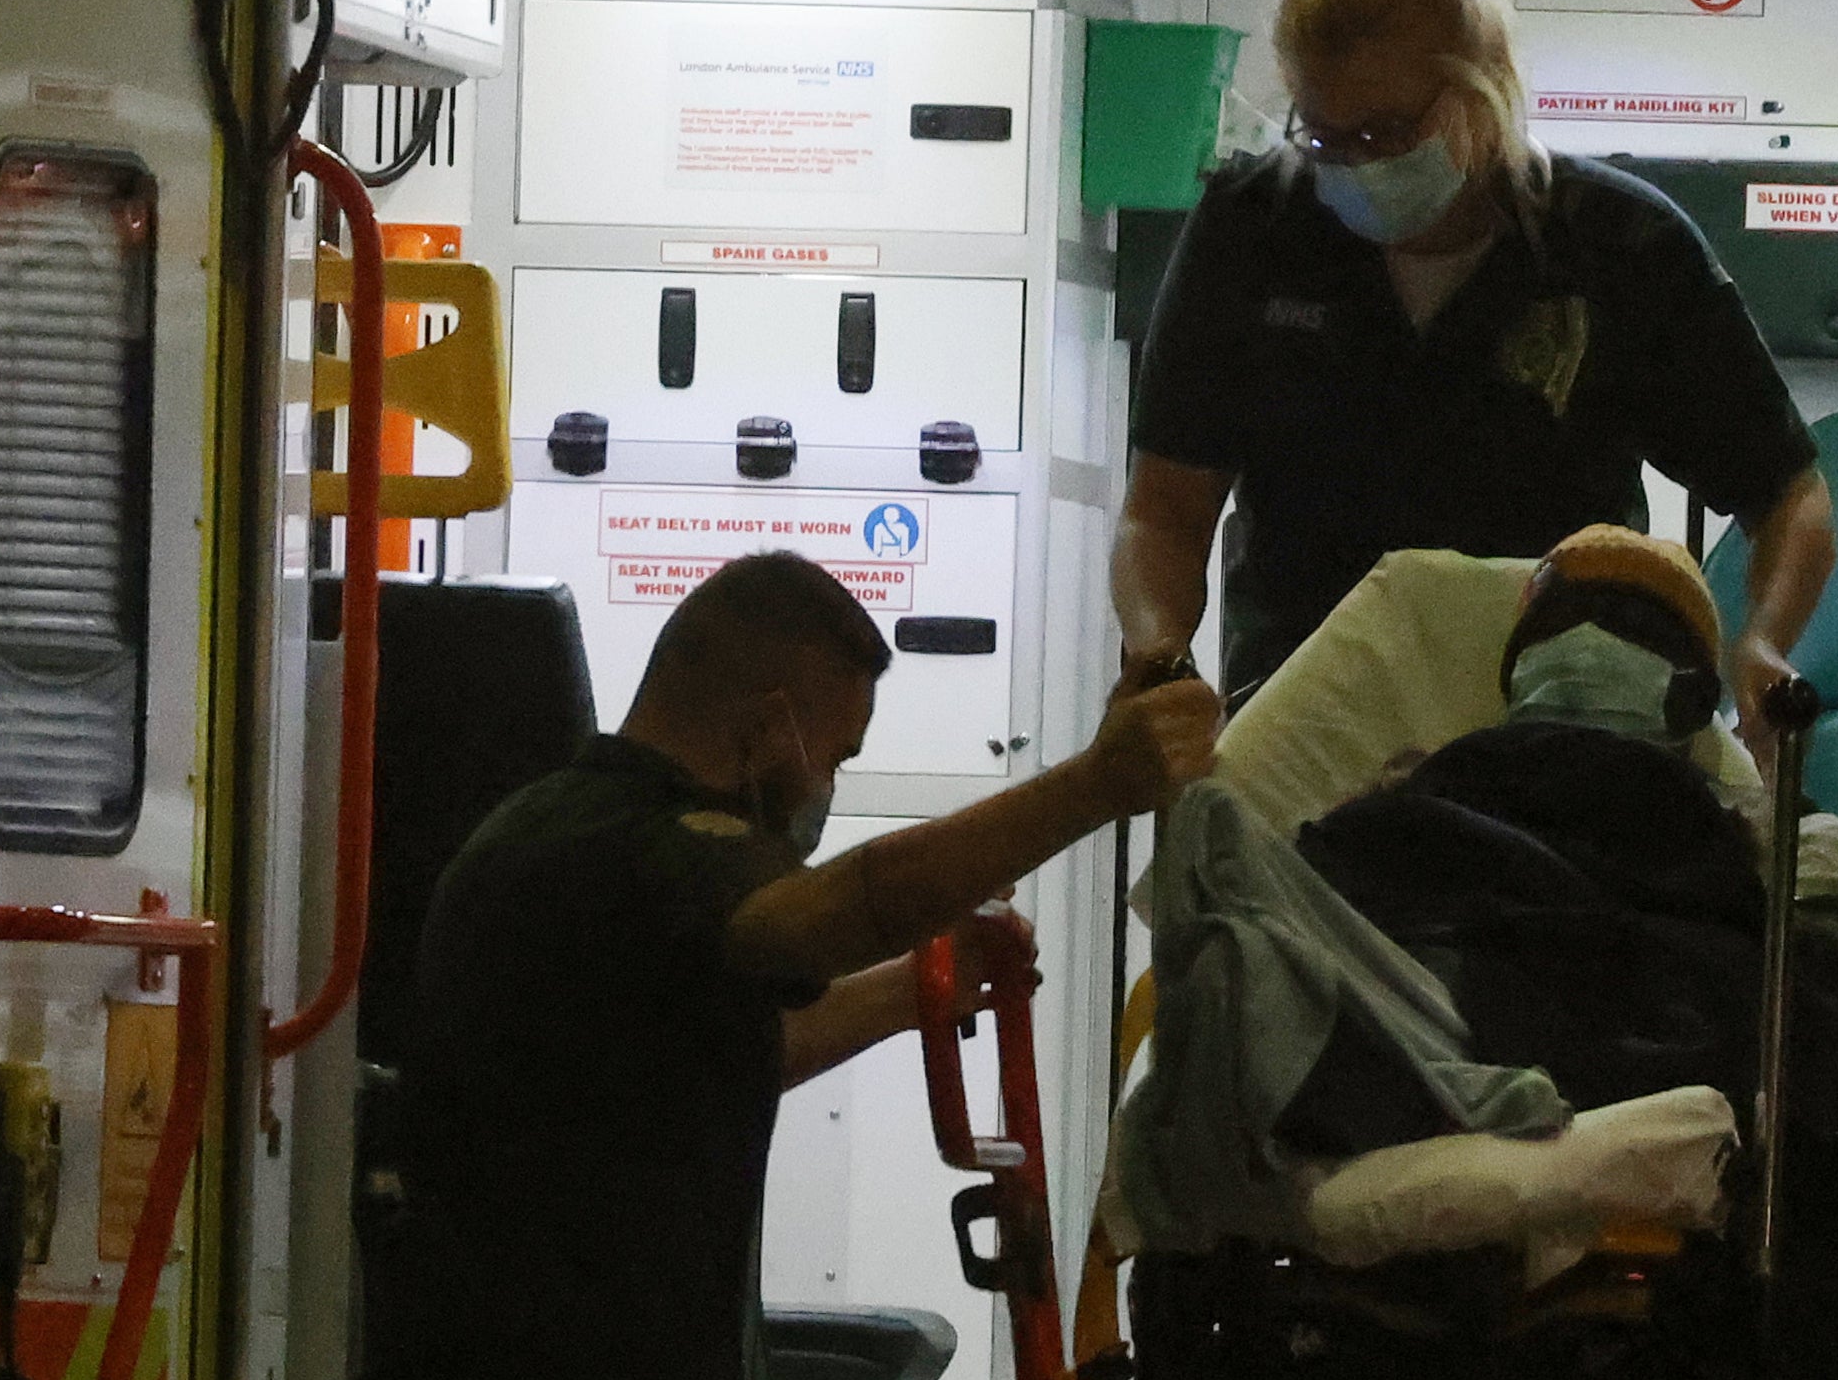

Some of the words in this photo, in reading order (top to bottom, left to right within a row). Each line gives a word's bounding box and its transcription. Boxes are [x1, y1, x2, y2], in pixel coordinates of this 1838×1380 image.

[679, 62, 722, 73] London
[725, 62, 789, 74] Ambulance
[792, 63, 831, 75] Service
[838, 62, 873, 76] NHS
[1537, 98, 1608, 111] PATIENT
[1614, 99, 1703, 113] HANDLING
[1708, 101, 1736, 114] KIT
[1757, 191, 1826, 206] SLIDING
[1770, 209, 1822, 223] WHEN
[712, 246, 766, 261] SPARE
[772, 247, 829, 262] GASES
[608, 517, 651, 530] SEAT
[657, 517, 711, 531] BELTS
[716, 519, 766, 533] MUST
[771, 520, 793, 534] BE
[799, 521, 852, 536] WORN
[617, 564, 661, 577] SEAT
[830, 570, 905, 584] ORWARD
[634, 582, 686, 595] WHEN
